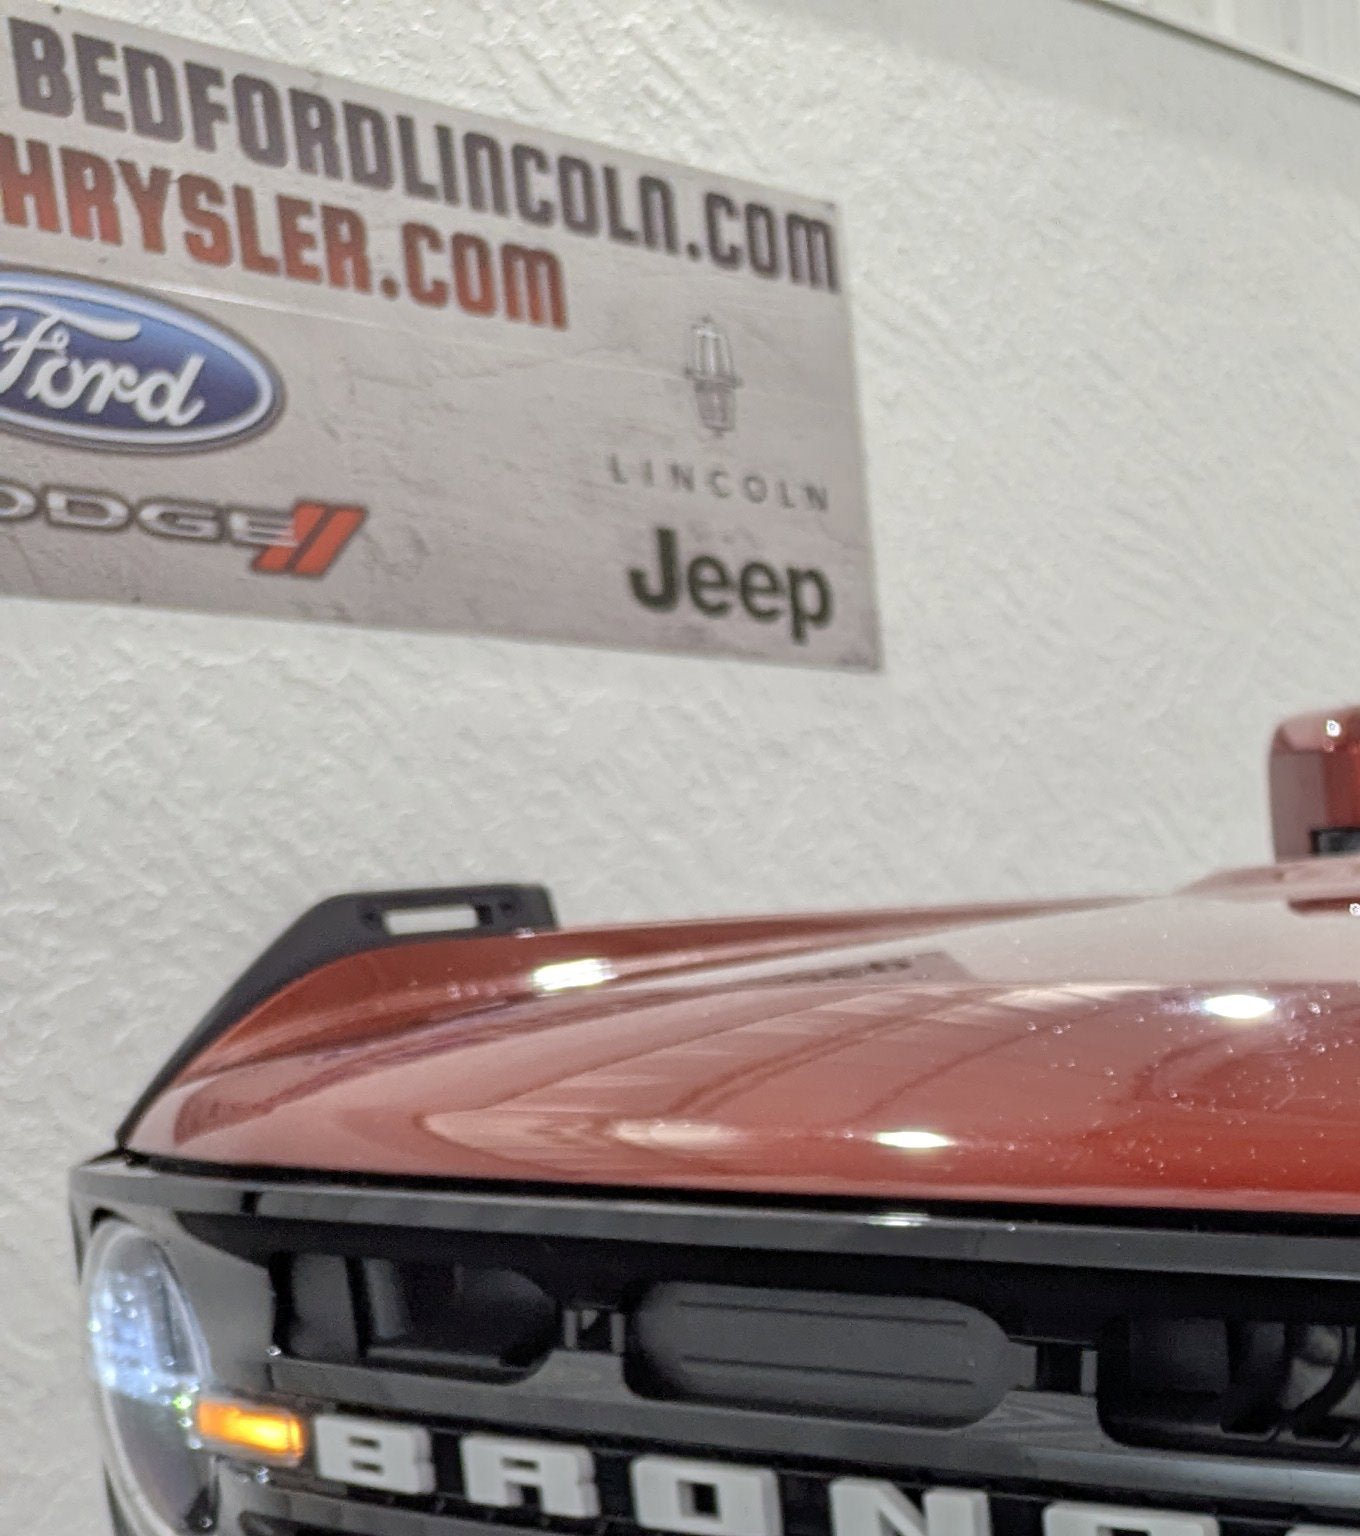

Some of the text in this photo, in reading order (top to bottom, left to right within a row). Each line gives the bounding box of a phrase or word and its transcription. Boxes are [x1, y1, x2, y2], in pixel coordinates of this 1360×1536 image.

[0, 293, 208, 427] Ford
[606, 452, 830, 512] LINCOLN
[628, 525, 836, 646] Jeep
